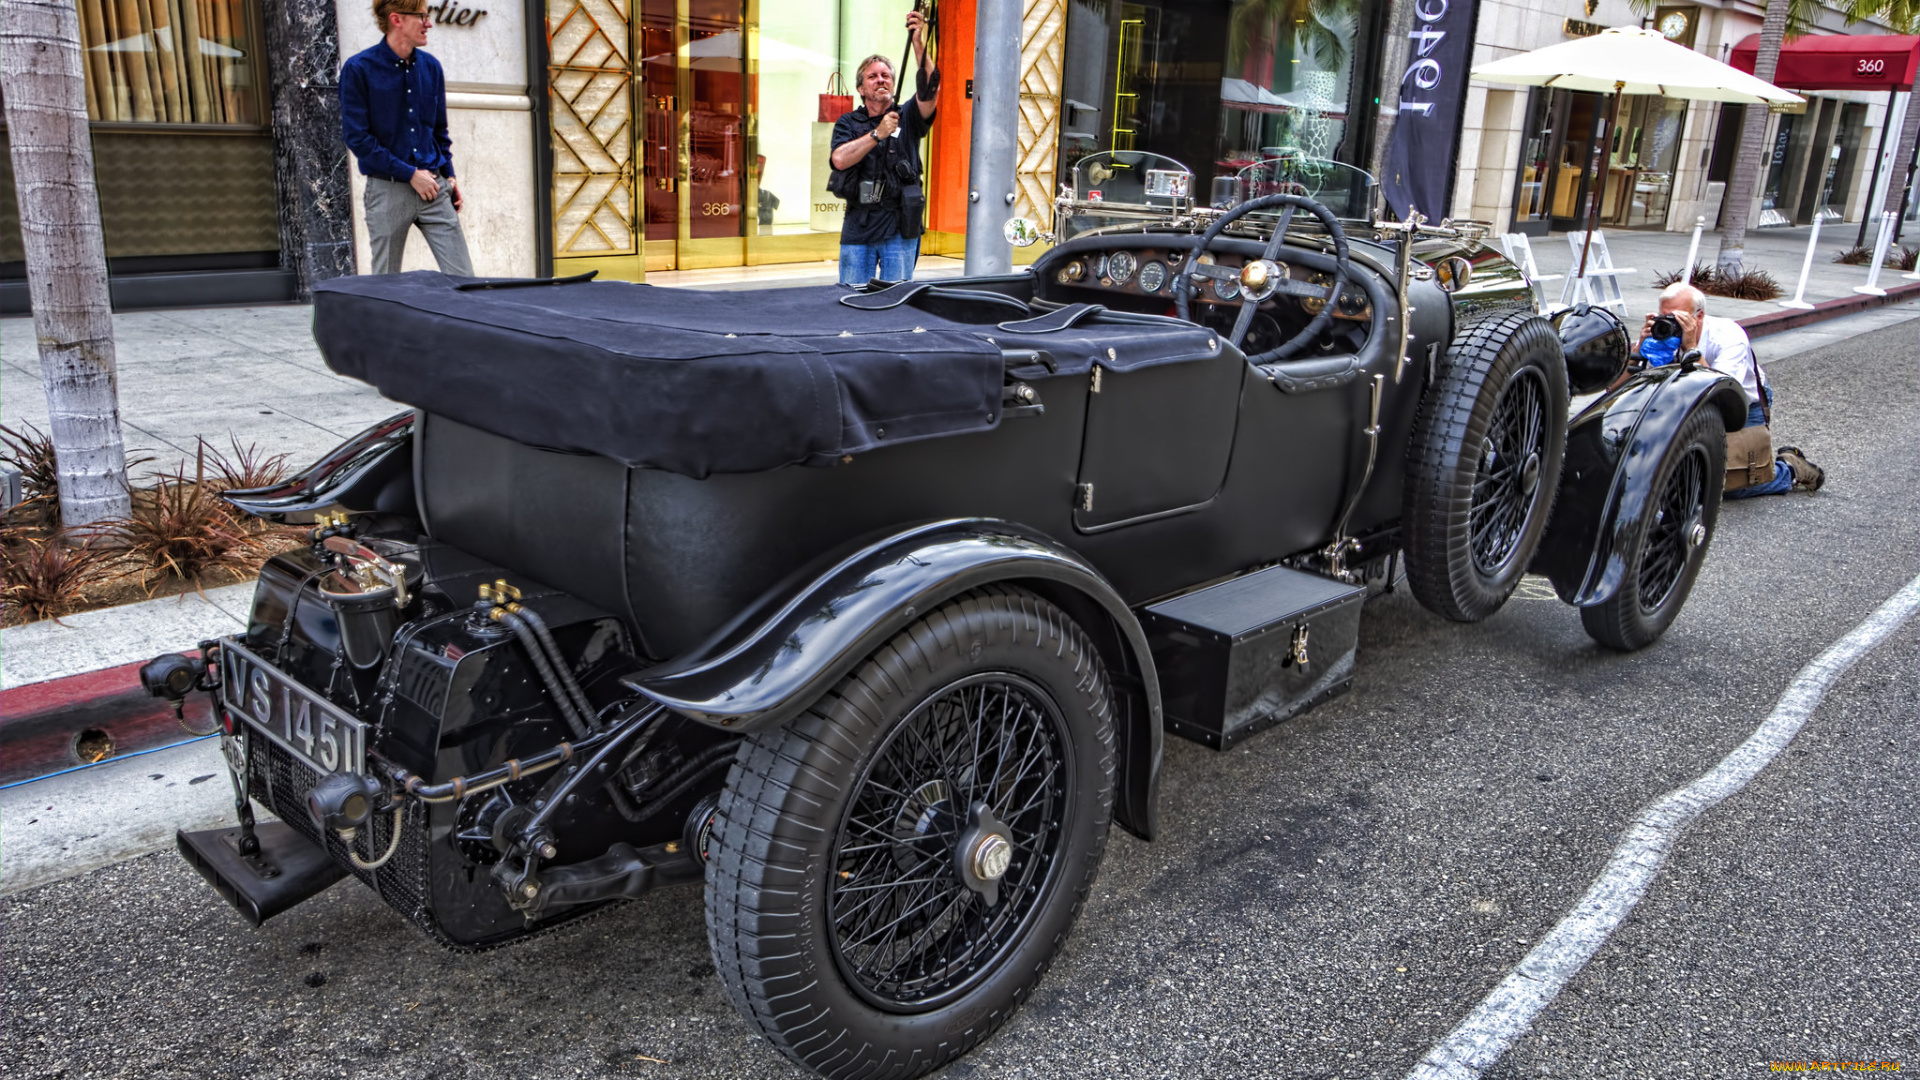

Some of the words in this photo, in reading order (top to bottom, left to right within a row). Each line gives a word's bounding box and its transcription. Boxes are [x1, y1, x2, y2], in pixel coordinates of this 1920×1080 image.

[427, 0, 487, 27] rtier
[1857, 59, 1884, 72] 360
[702, 202, 730, 216] 366
[814, 203, 840, 213] TORY
[228, 650, 271, 724] VS
[283, 686, 352, 773] 1451
[225, 740, 241, 770] GB
